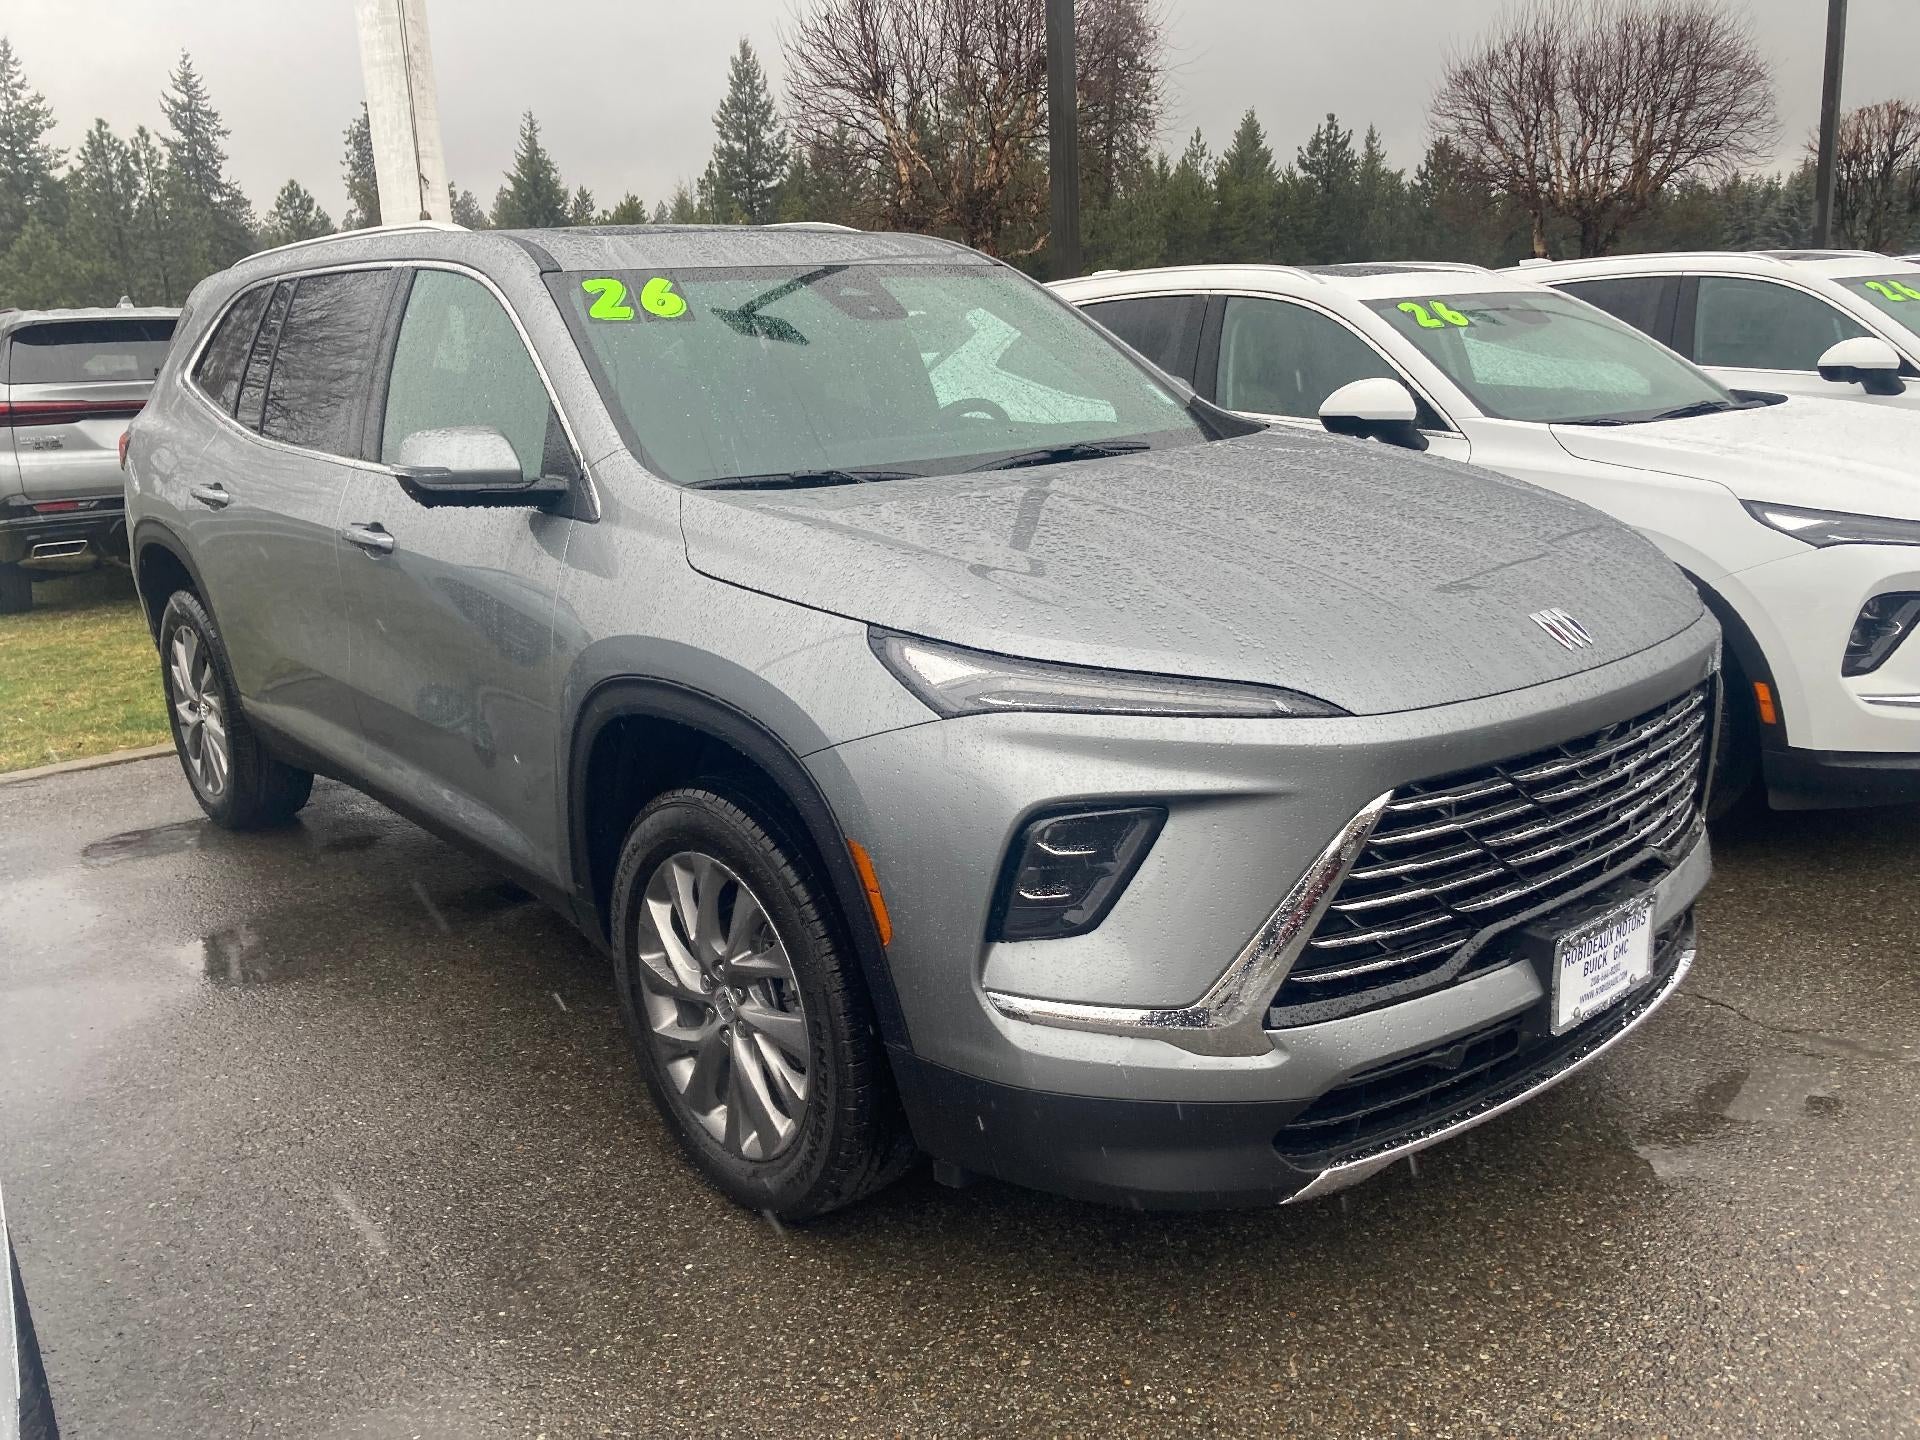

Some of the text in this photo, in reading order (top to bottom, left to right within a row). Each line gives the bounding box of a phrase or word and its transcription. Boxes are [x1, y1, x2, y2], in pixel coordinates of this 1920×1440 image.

[581, 277, 687, 320] 26
[1864, 280, 1920, 301] 26
[1397, 301, 1469, 327] 26
[1564, 910, 1647, 968] ROBIDEAUX MOTORS
[1583, 939, 1629, 976] BUICK GMC
